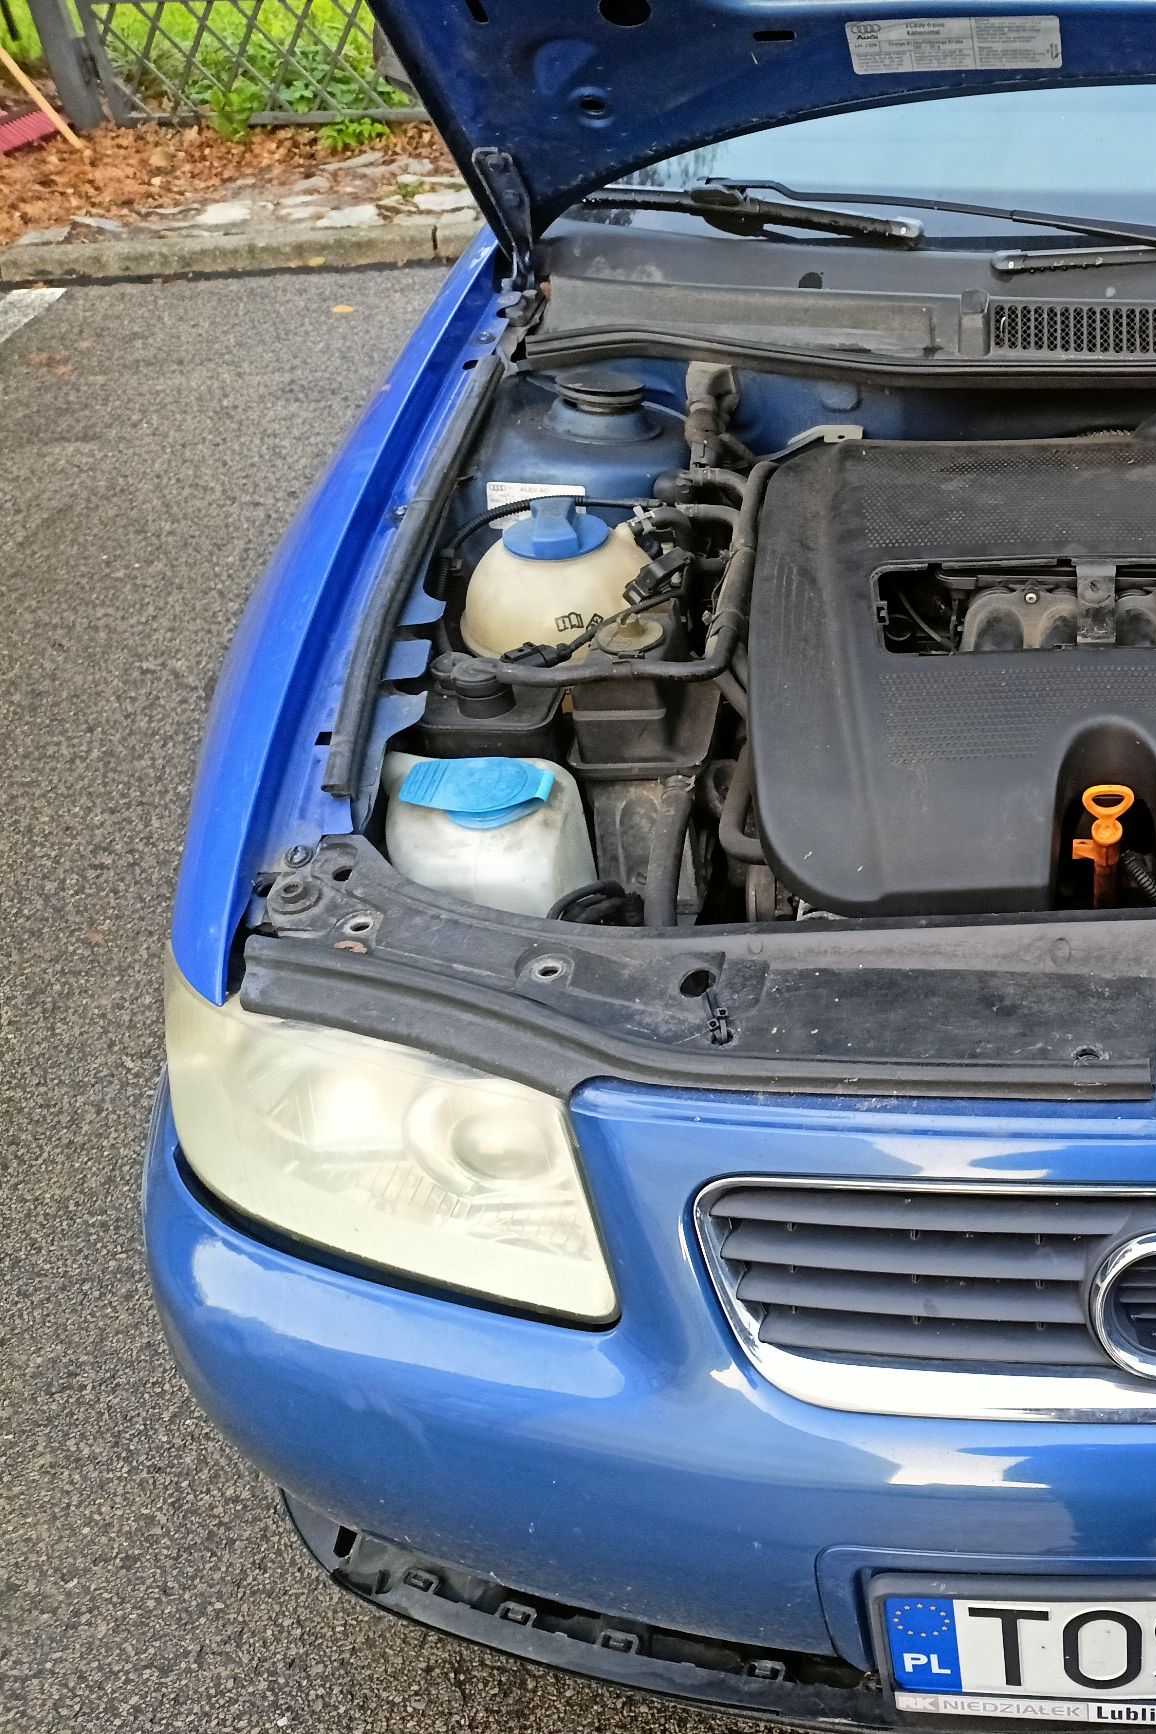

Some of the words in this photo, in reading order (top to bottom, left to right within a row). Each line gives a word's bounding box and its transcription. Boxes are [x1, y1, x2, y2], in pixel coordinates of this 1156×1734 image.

[903, 1653, 951, 1674] PL
[898, 1696, 936, 1711] RK
[943, 1700, 1081, 1717] NIEDZIAŁEK
